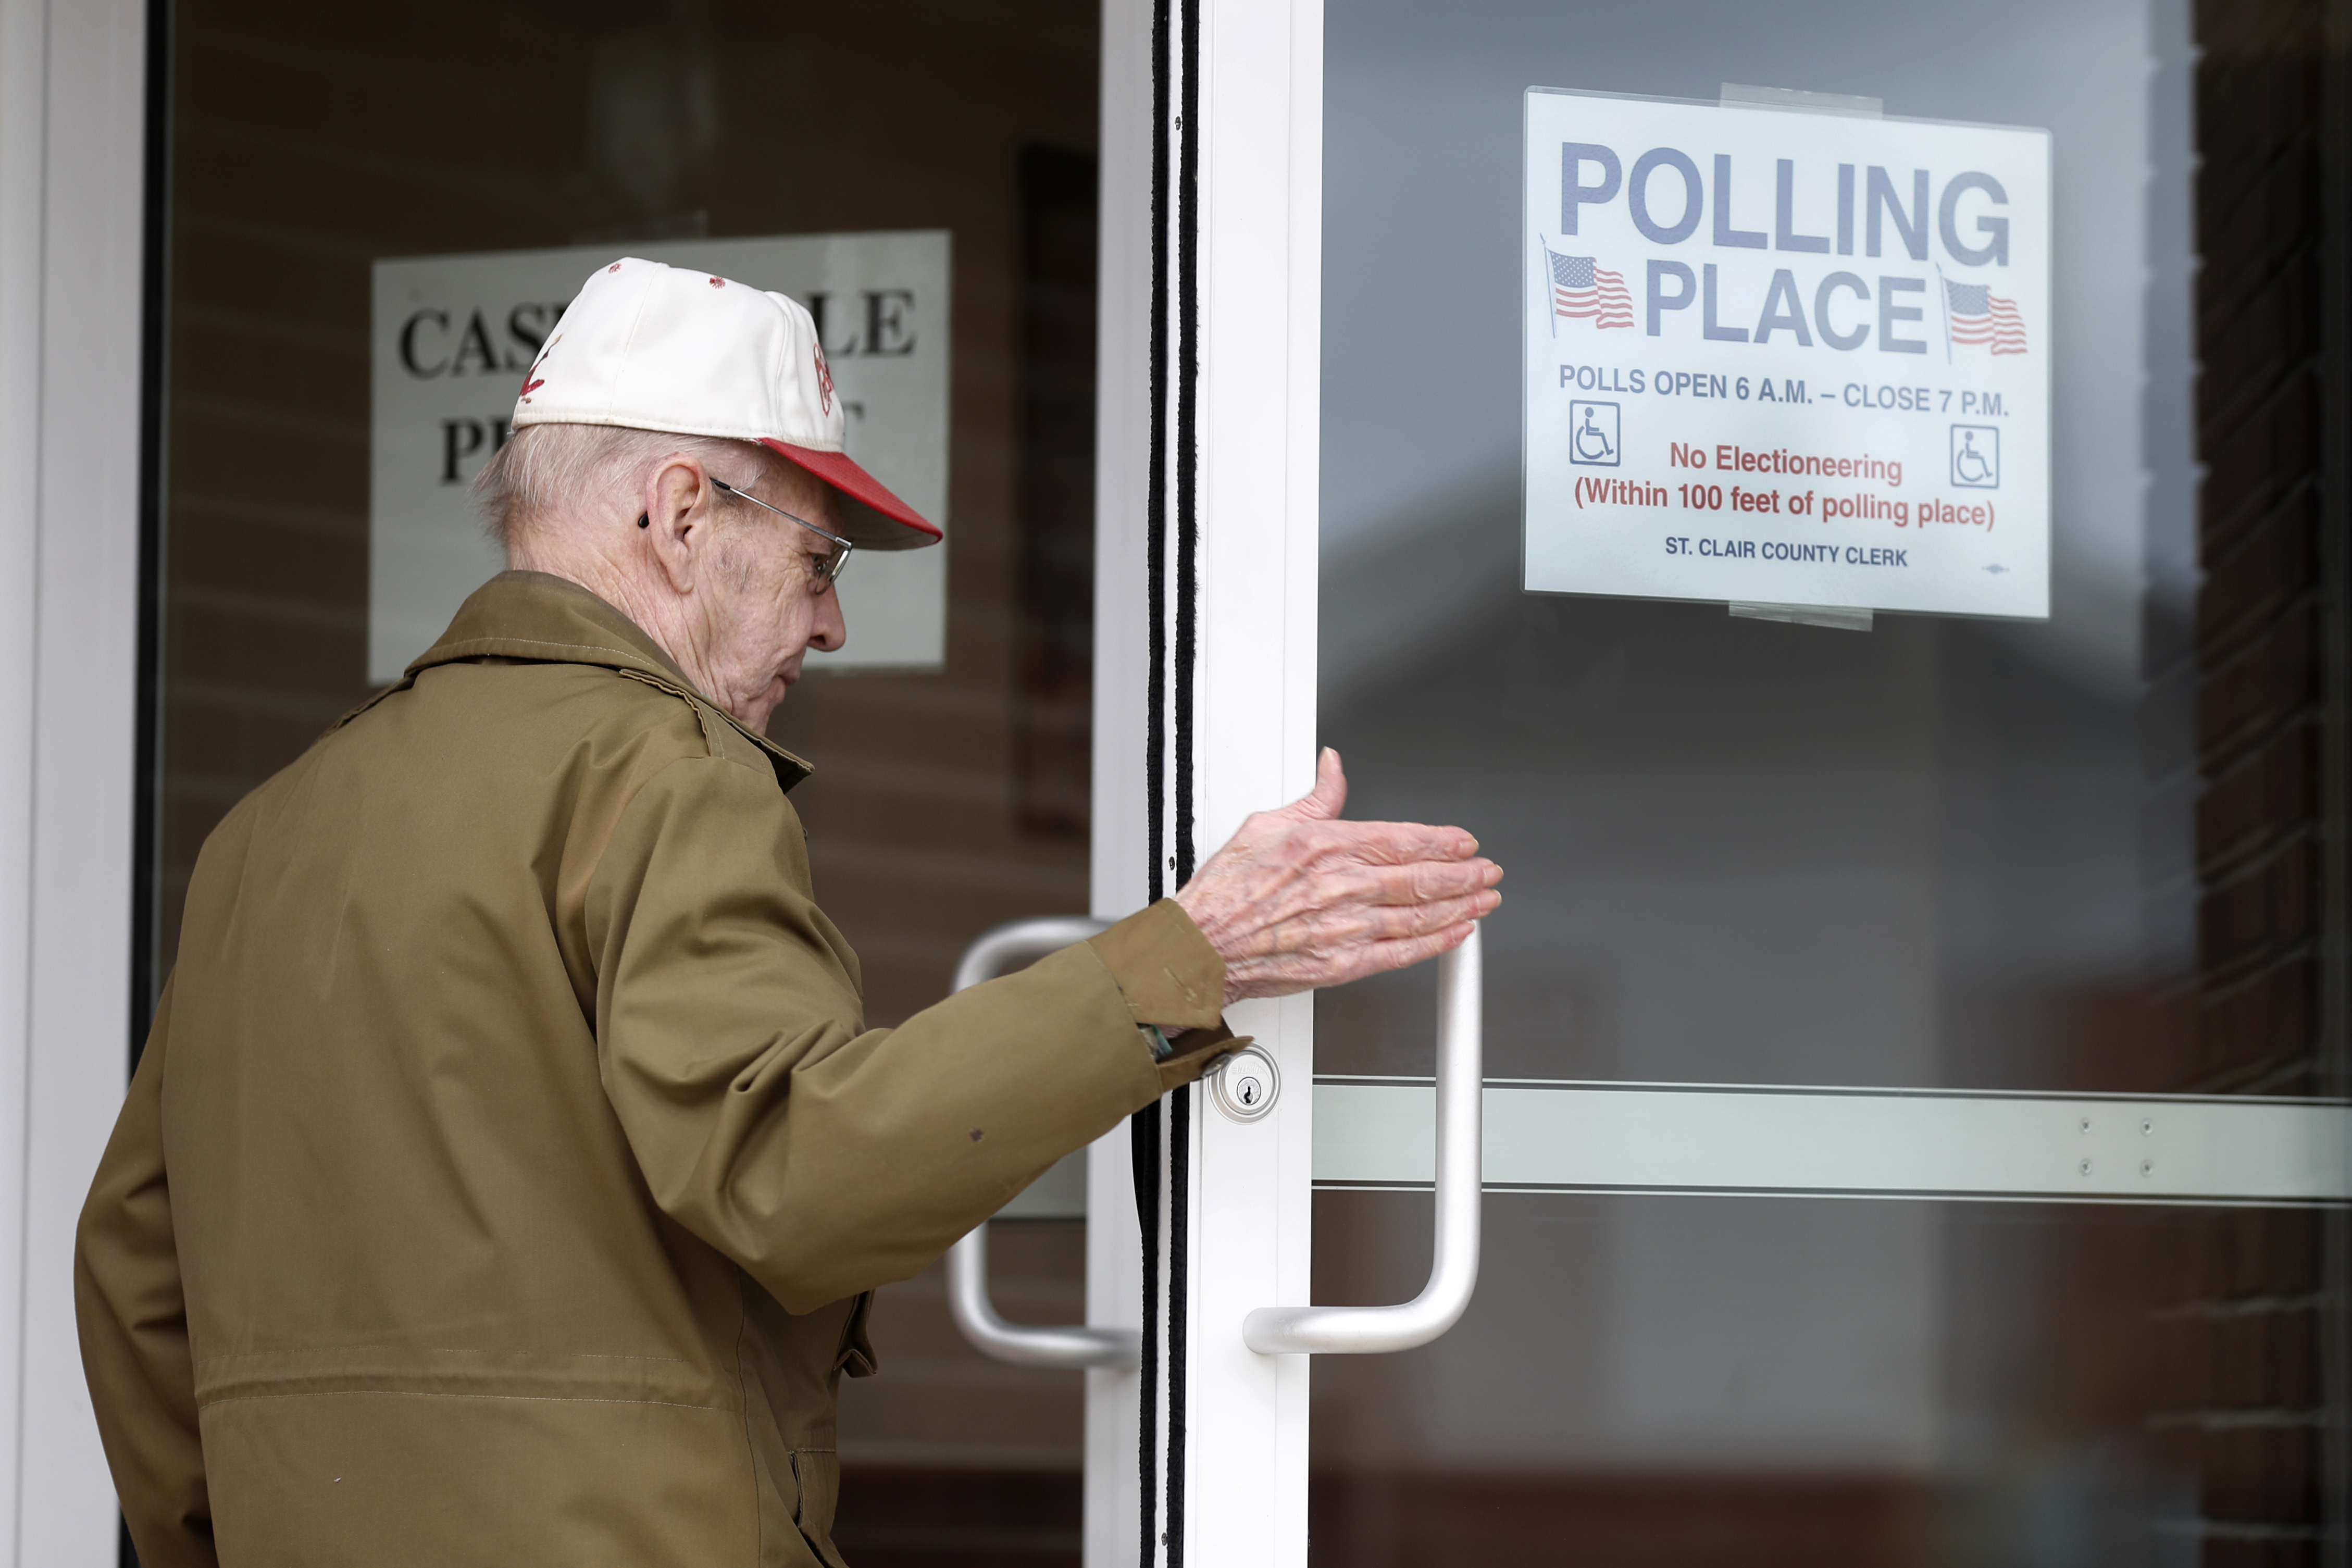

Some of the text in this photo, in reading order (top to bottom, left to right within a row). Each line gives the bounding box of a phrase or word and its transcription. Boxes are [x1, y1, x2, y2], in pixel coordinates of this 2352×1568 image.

[1561, 141, 2010, 268] POLLING
[1646, 258, 1928, 355] PLACE
[399, 289, 918, 381] CASLE
[1560, 364, 1646, 394] POLLS
[1654, 370, 1727, 400] OPEN
[1735, 376, 1750, 401] 6
[1757, 377, 1813, 405] A.M.
[1843, 382, 1931, 412] CLOSE
[1938, 389, 1953, 413] 7
[1961, 390, 2009, 417] P.M.
[1670, 441, 1902, 488] No Electioneering
[1574, 476, 1995, 532] (Within 100 feet of polling place)
[1665, 536, 1909, 568] ST. CLAIR COUNTY CLERK
